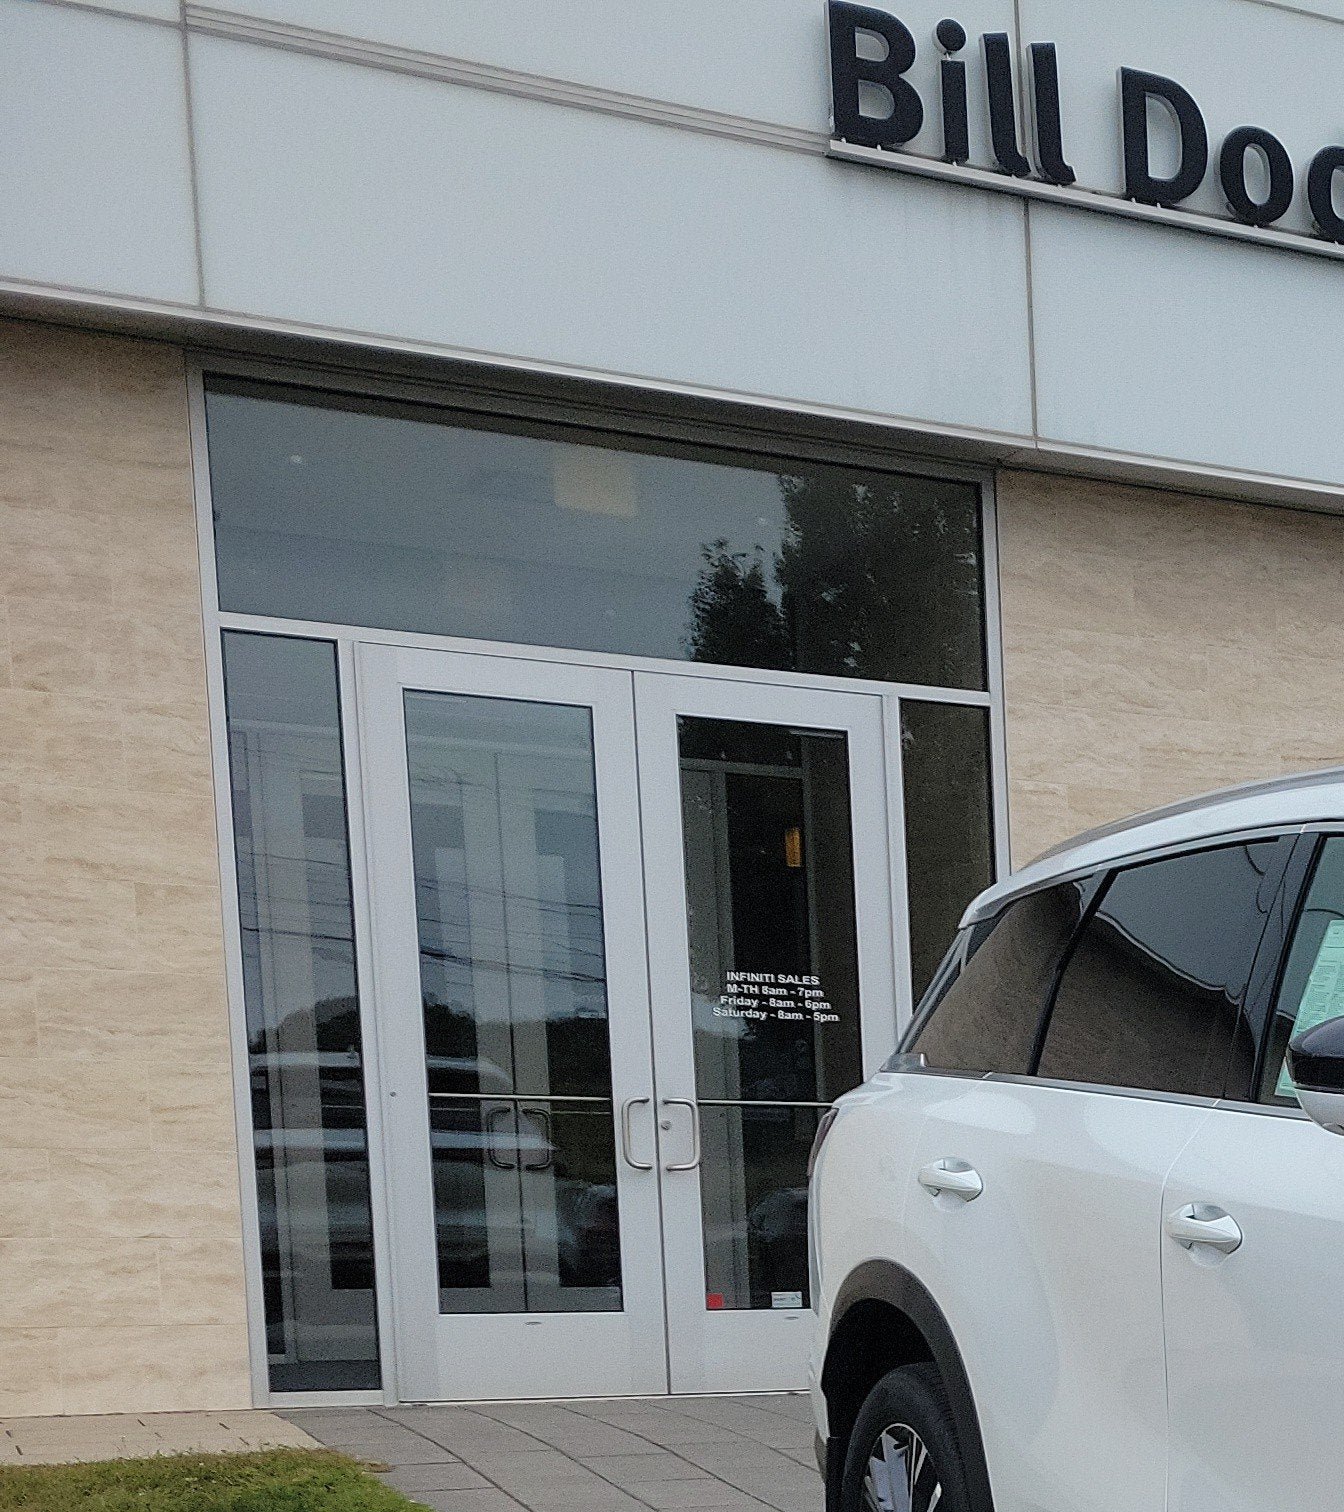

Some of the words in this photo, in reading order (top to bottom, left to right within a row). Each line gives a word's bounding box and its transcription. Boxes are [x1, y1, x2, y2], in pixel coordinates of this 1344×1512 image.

[828, 0, 1077, 186] Bill
[726, 971, 774, 982] INFINITI
[777, 974, 819, 985] SALES
[726, 984, 759, 994] M-TH
[797, 987, 824, 997] 7pm
[720, 995, 758, 1007] Friday
[769, 998, 795, 1007] 8am
[804, 1000, 831, 1010] 6pm
[712, 1007, 767, 1020] Saturday
[777, 1010, 803, 1020] 8am
[813, 1012, 839, 1022] 5pm
